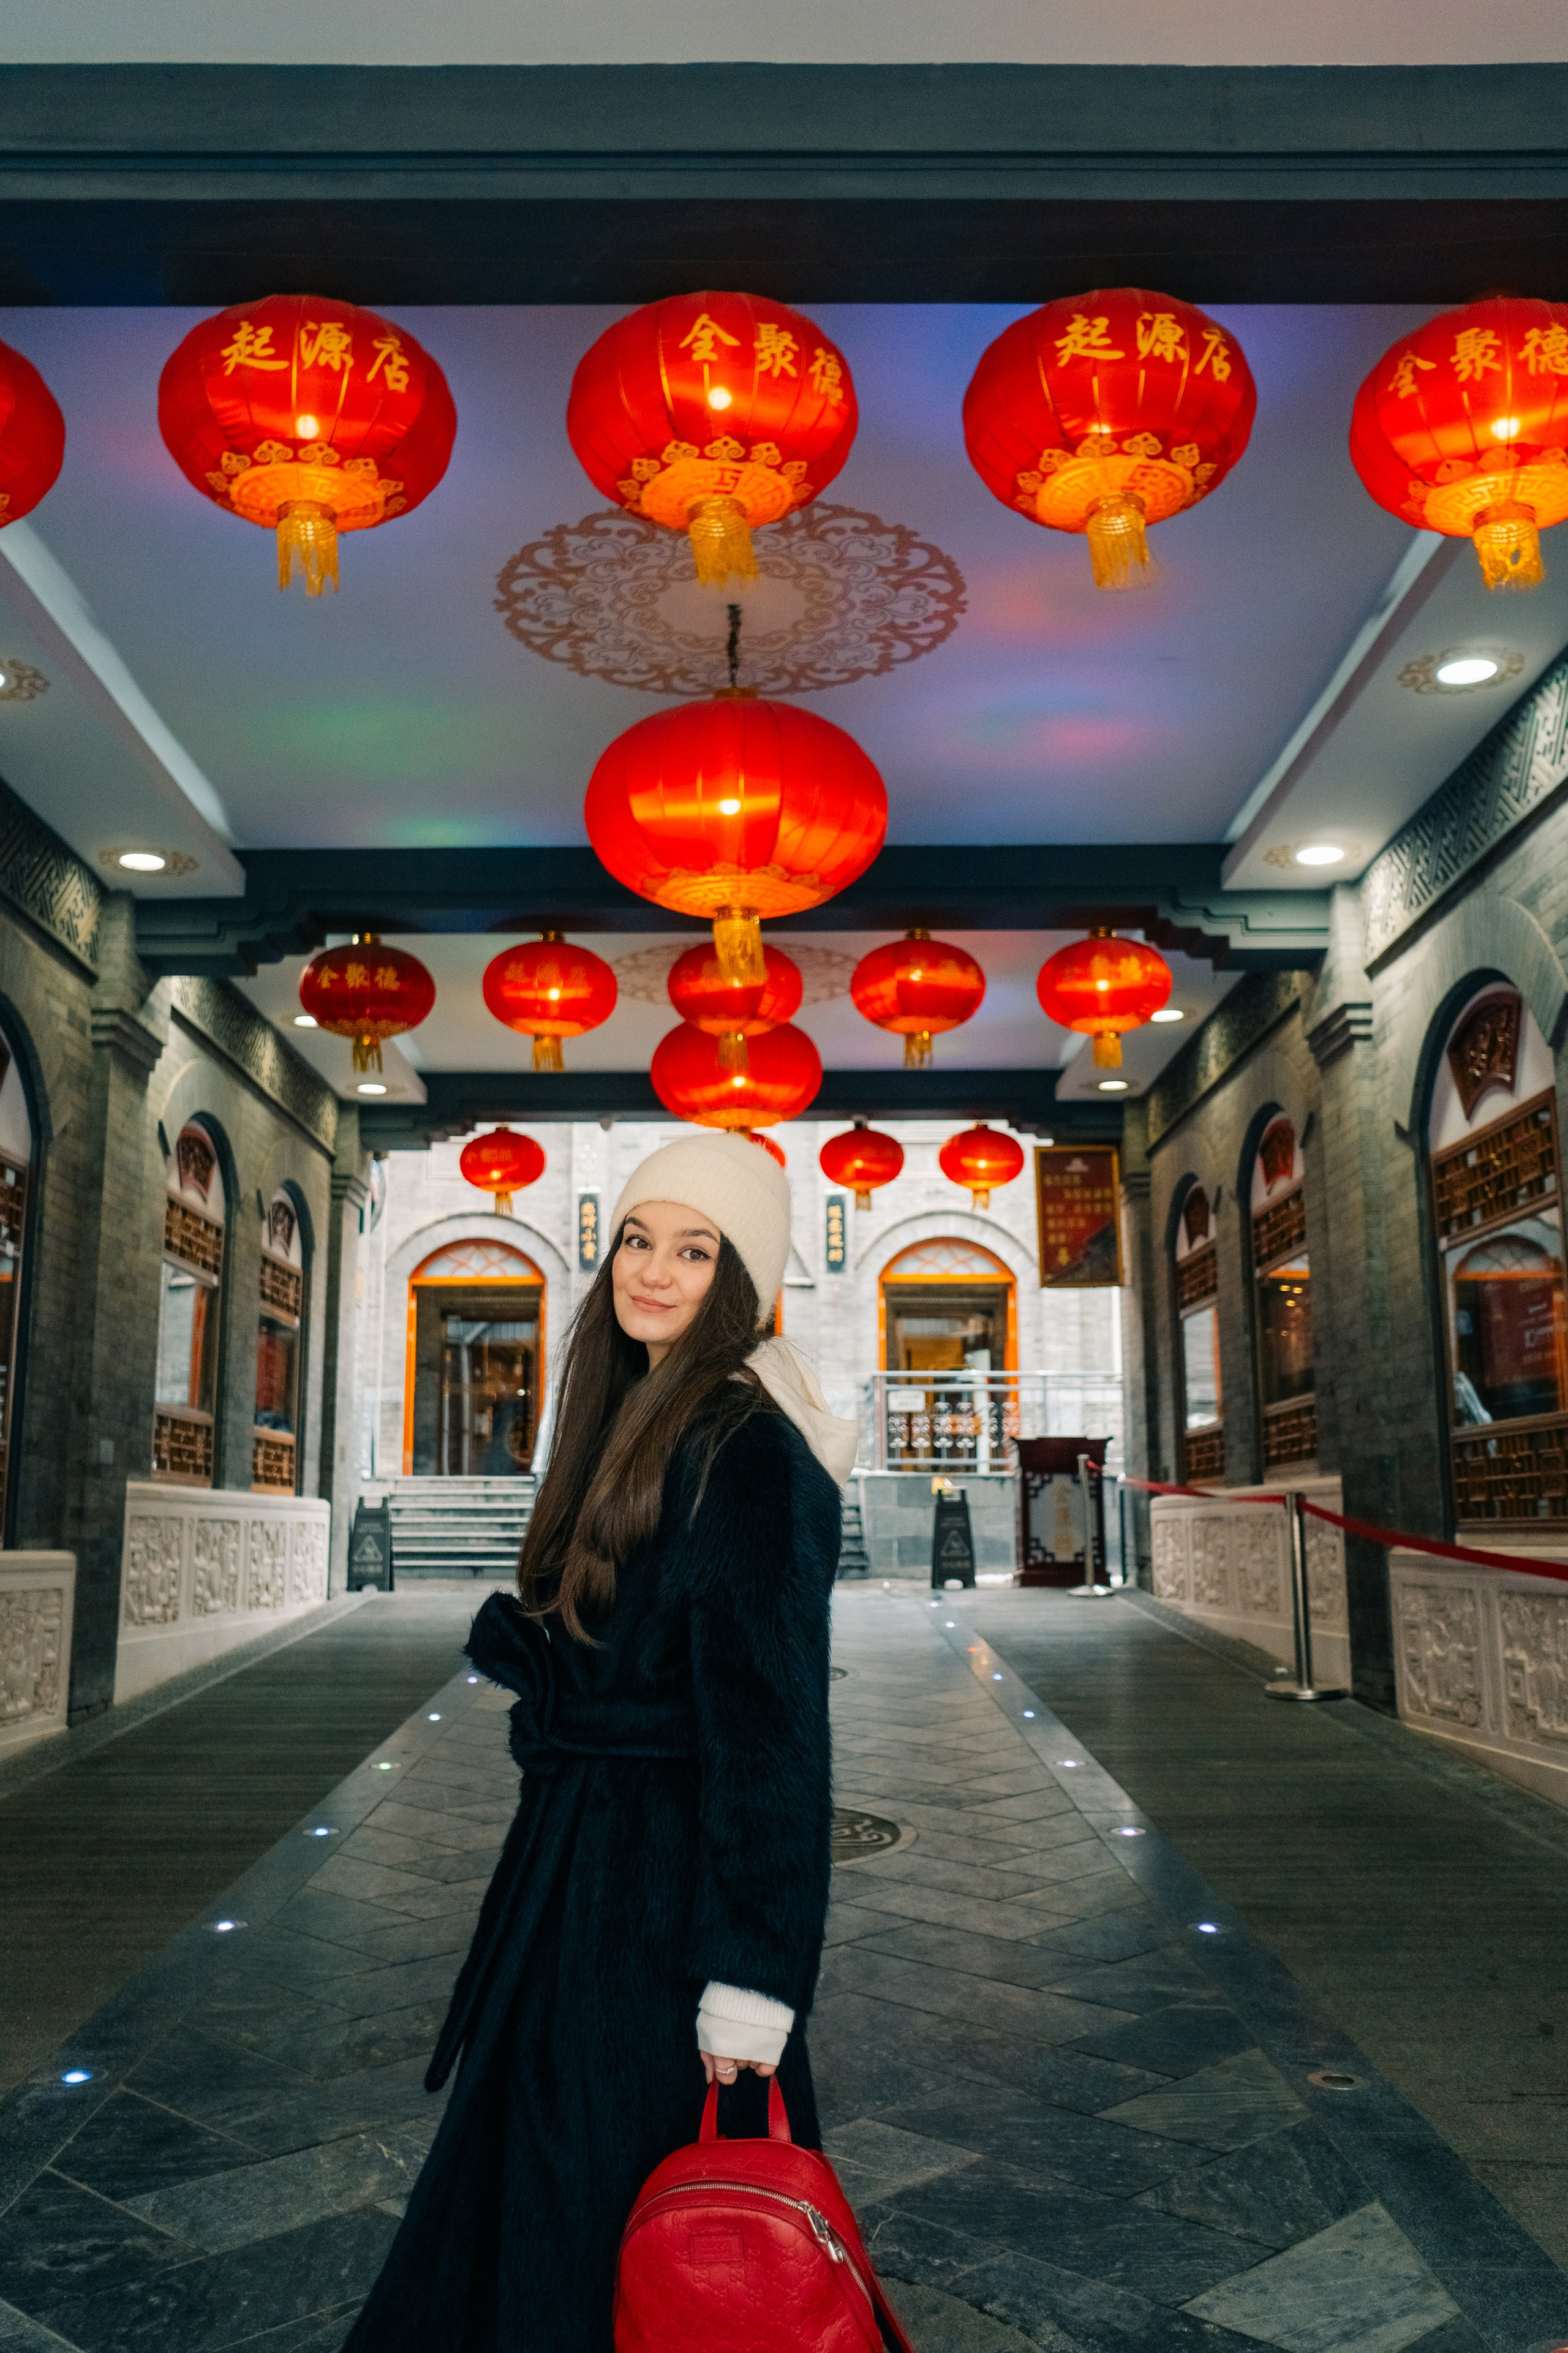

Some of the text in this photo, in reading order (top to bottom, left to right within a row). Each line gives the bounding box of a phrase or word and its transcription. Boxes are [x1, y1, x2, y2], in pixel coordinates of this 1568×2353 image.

[221, 320, 409, 393] 起源店
[679, 314, 843, 406] 全聚德
[1054, 311, 1231, 382] 起源店
[1387, 322, 1568, 399] 全聚德
